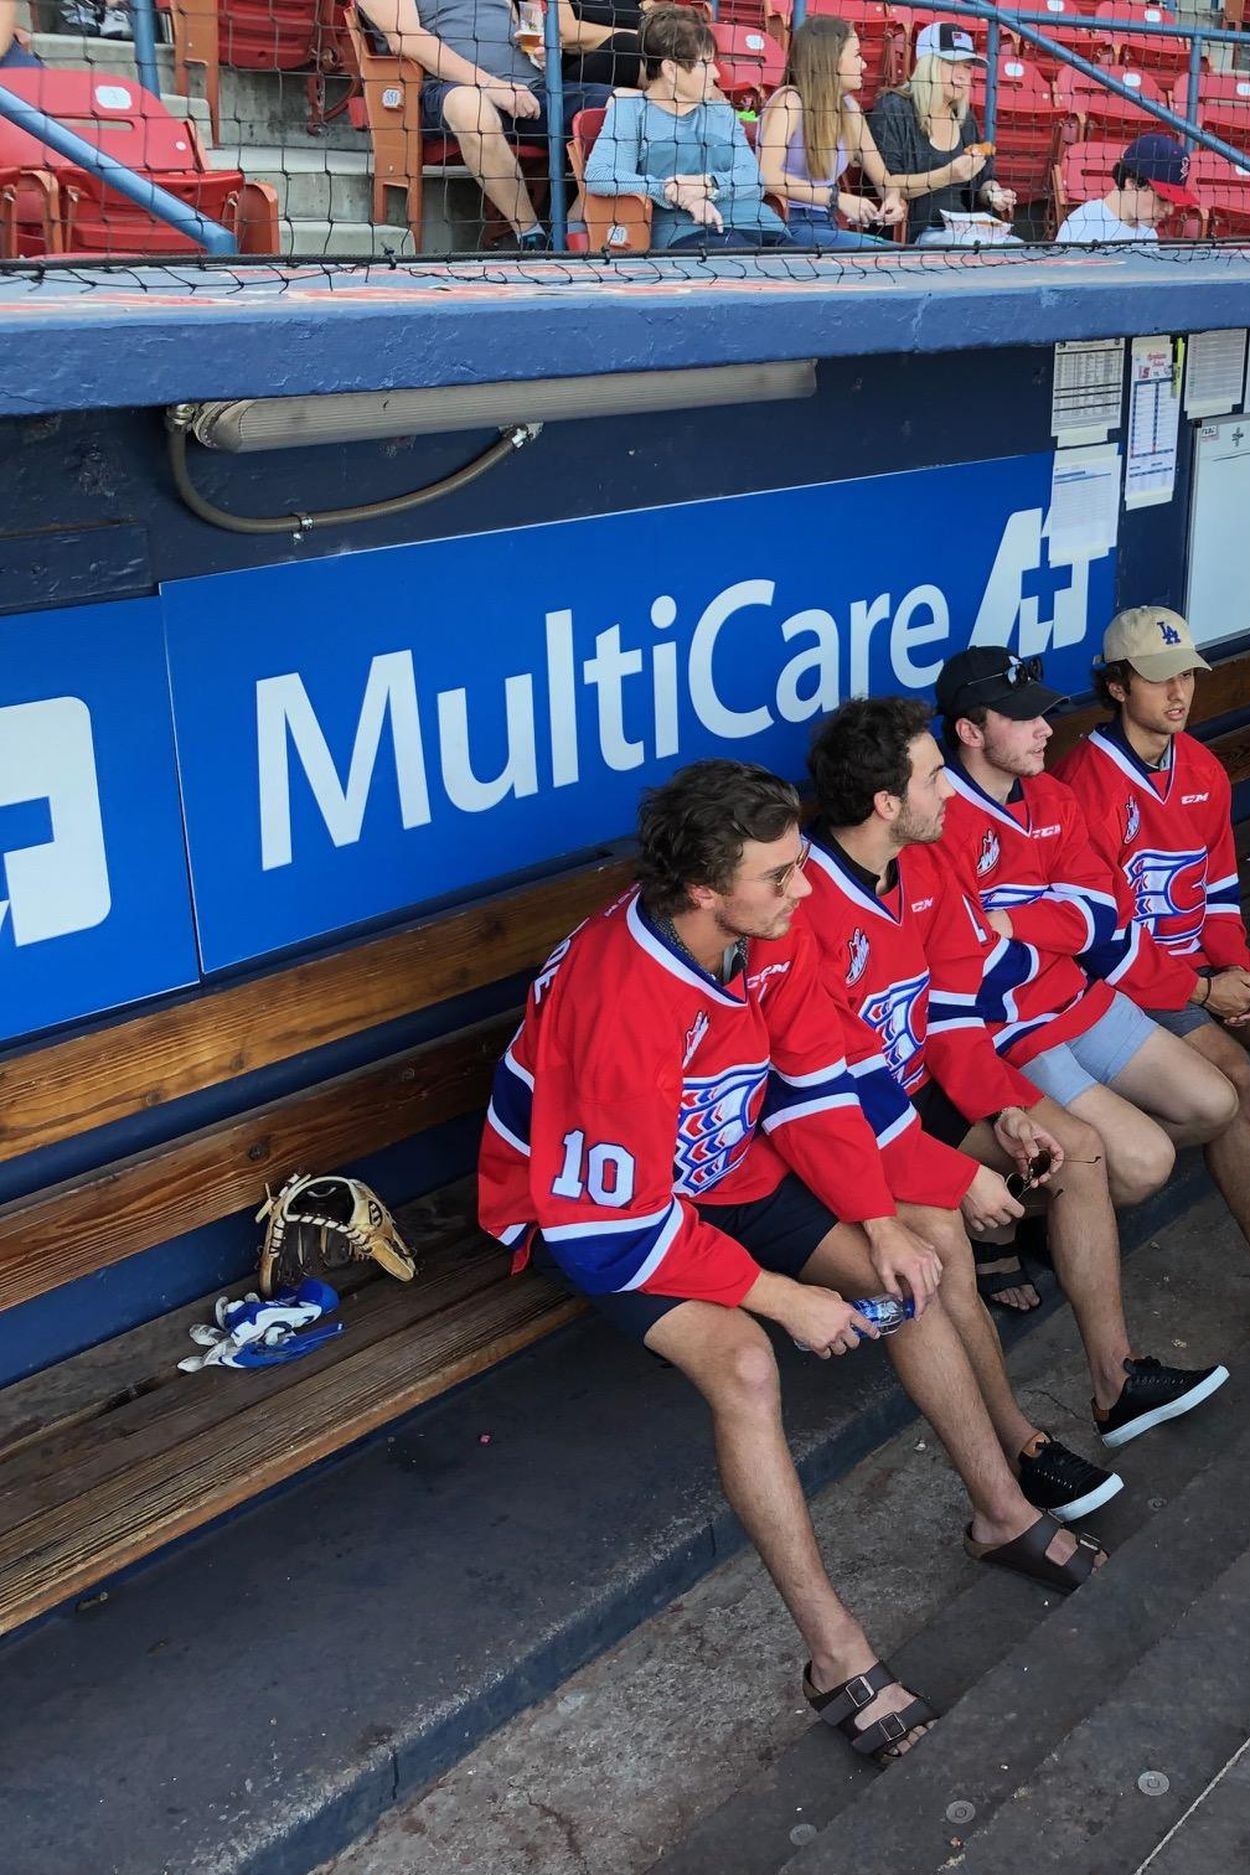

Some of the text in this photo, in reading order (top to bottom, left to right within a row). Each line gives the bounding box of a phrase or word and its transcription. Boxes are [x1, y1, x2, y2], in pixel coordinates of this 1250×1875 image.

[1156, 621, 1181, 645] LA
[257, 580, 949, 870] MultiCare
[551, 1129, 635, 1208] 10
